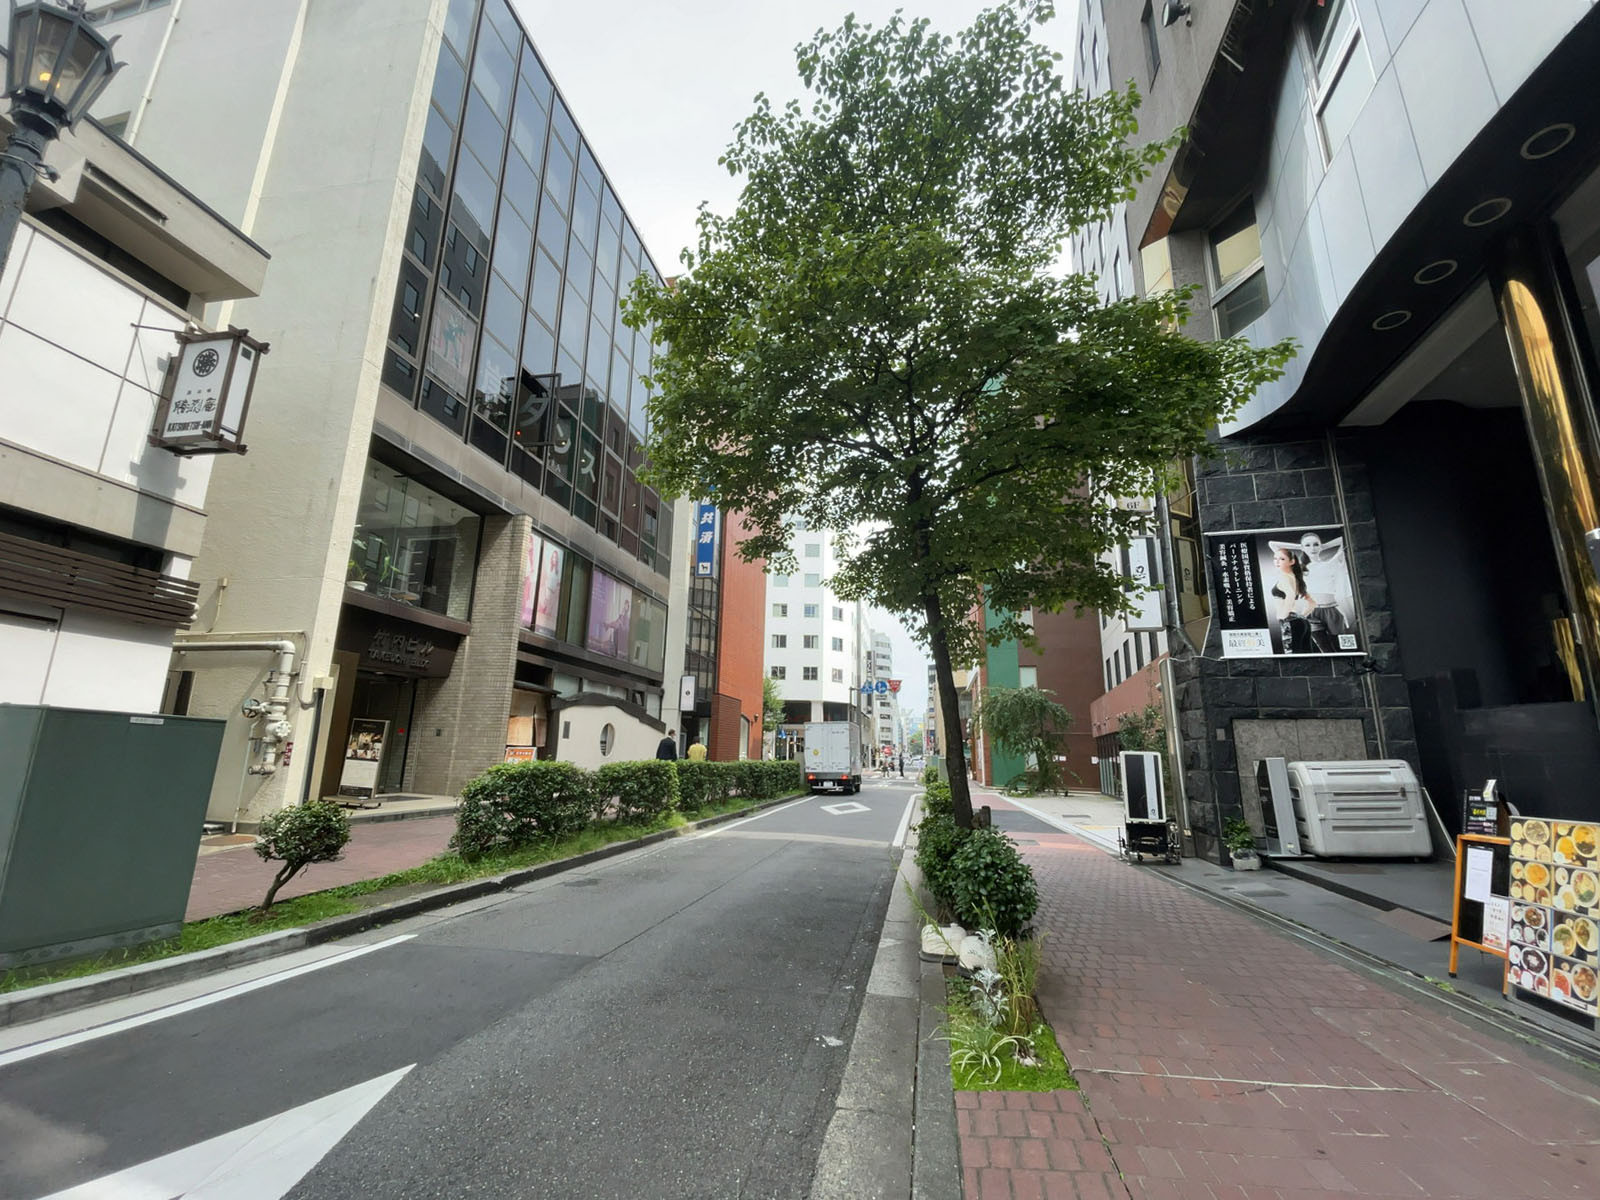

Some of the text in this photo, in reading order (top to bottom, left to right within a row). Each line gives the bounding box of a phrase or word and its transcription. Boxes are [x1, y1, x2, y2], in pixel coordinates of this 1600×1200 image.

[1229, 543, 1244, 605] パーソナルトレーニング
